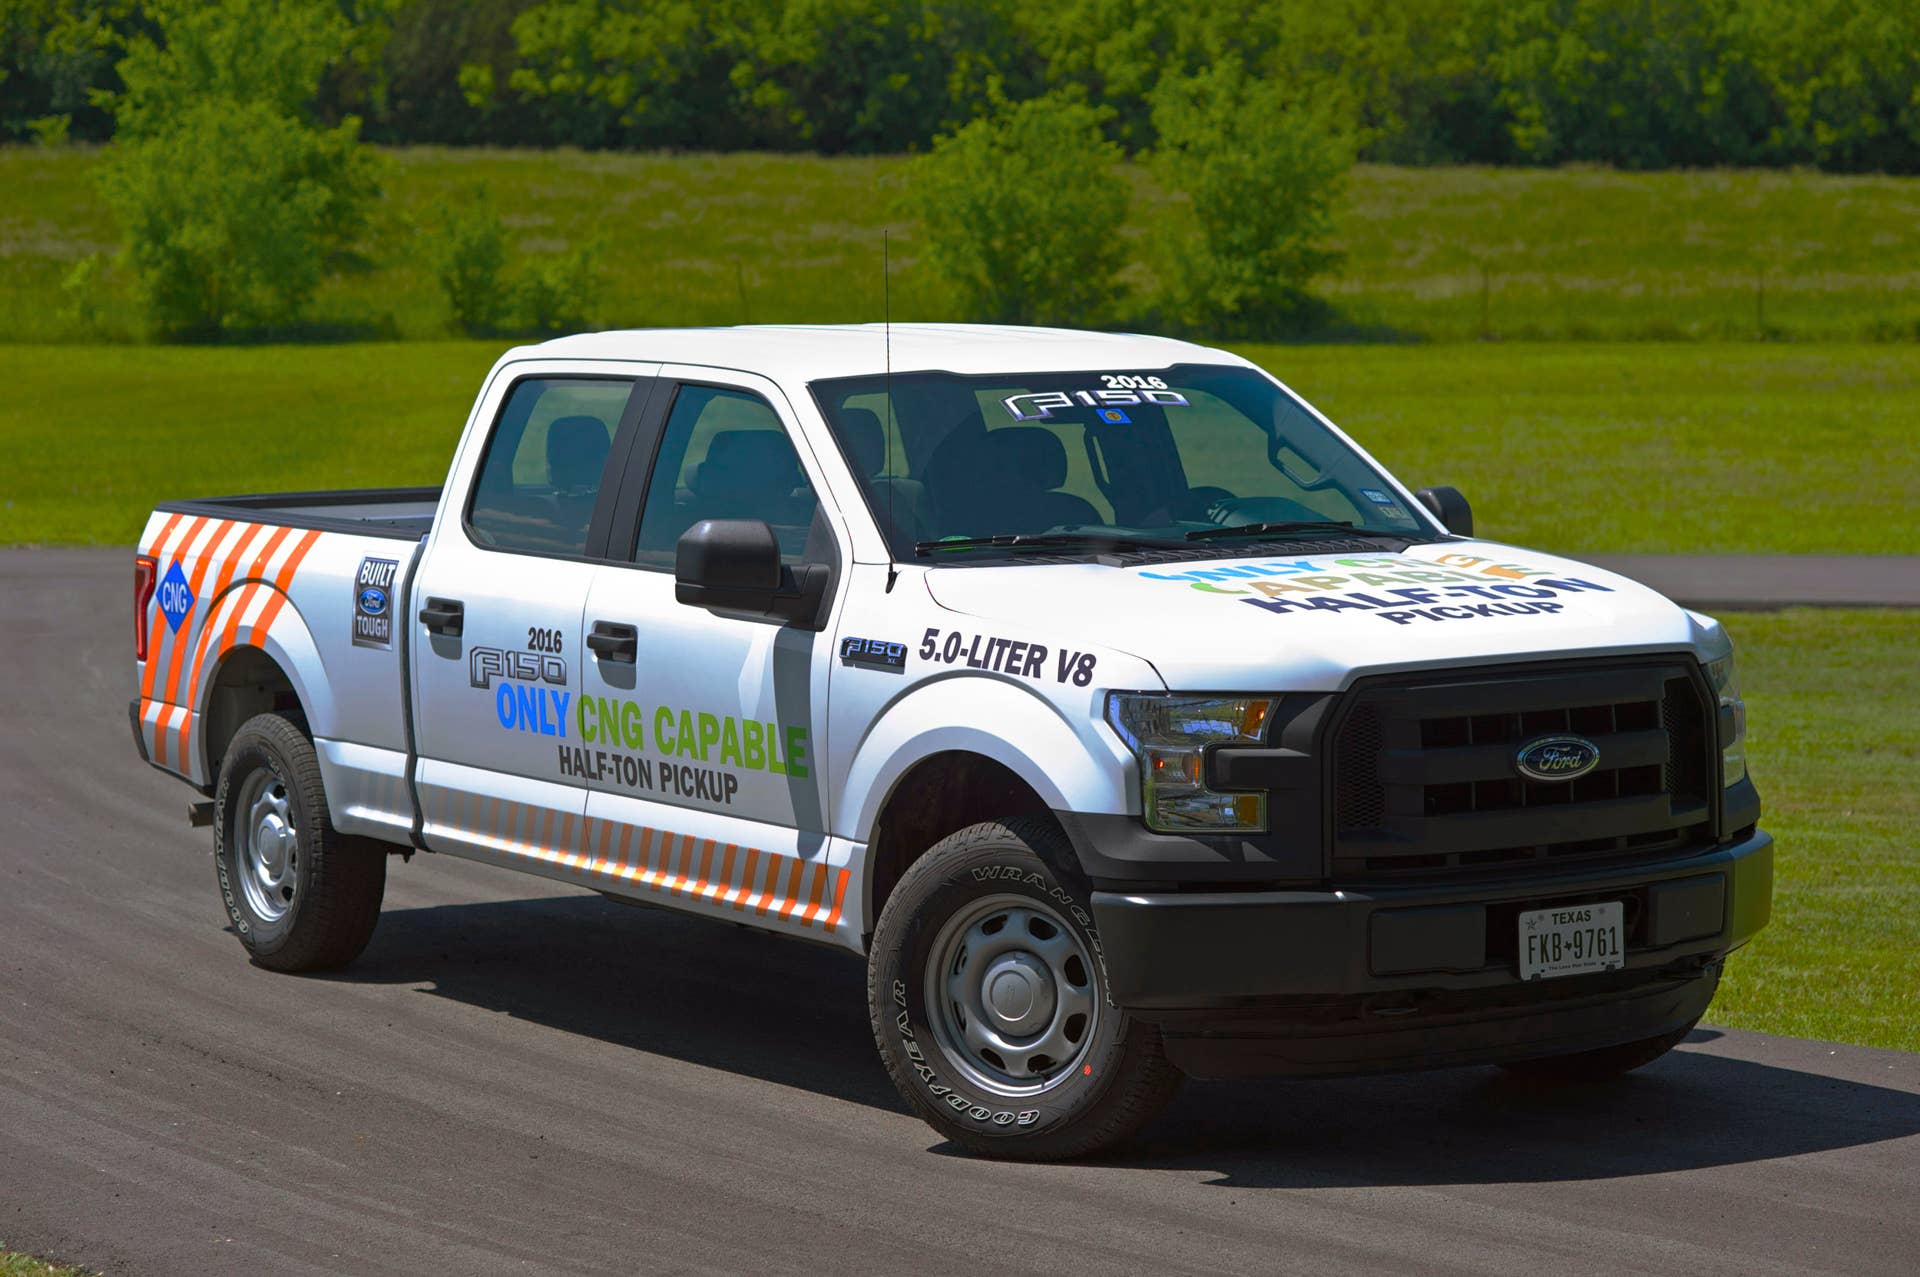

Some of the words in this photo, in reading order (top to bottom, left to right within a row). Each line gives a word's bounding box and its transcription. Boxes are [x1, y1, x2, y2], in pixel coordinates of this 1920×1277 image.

[1100, 375, 1168, 390] 2016
[360, 561, 396, 587] BUILT
[1138, 561, 1327, 582] ONLY
[1190, 564, 1555, 597] CAPABLE
[162, 583, 188, 614] CNG
[363, 591, 382, 609] Ford
[1238, 577, 1616, 614] HALF-TON
[357, 615, 389, 638] TOUGH
[1375, 601, 1564, 626] PICKUP
[527, 626, 563, 654] 2016
[918, 627, 1048, 679] 5.0-LITER
[1056, 648, 1098, 688] V8
[496, 682, 571, 738] ONLY
[576, 694, 645, 751] CNG
[654, 705, 809, 779] CAPABLE
[1538, 746, 1582, 771] Ford
[558, 745, 653, 792] HALF-TON
[659, 764, 739, 805] PICKUP
[1551, 910, 1592, 926] TEXAS
[1528, 932, 1562, 965] FKB
[1573, 926, 1619, 959] 9761
[893, 979, 1040, 1126] GOODYEAR
